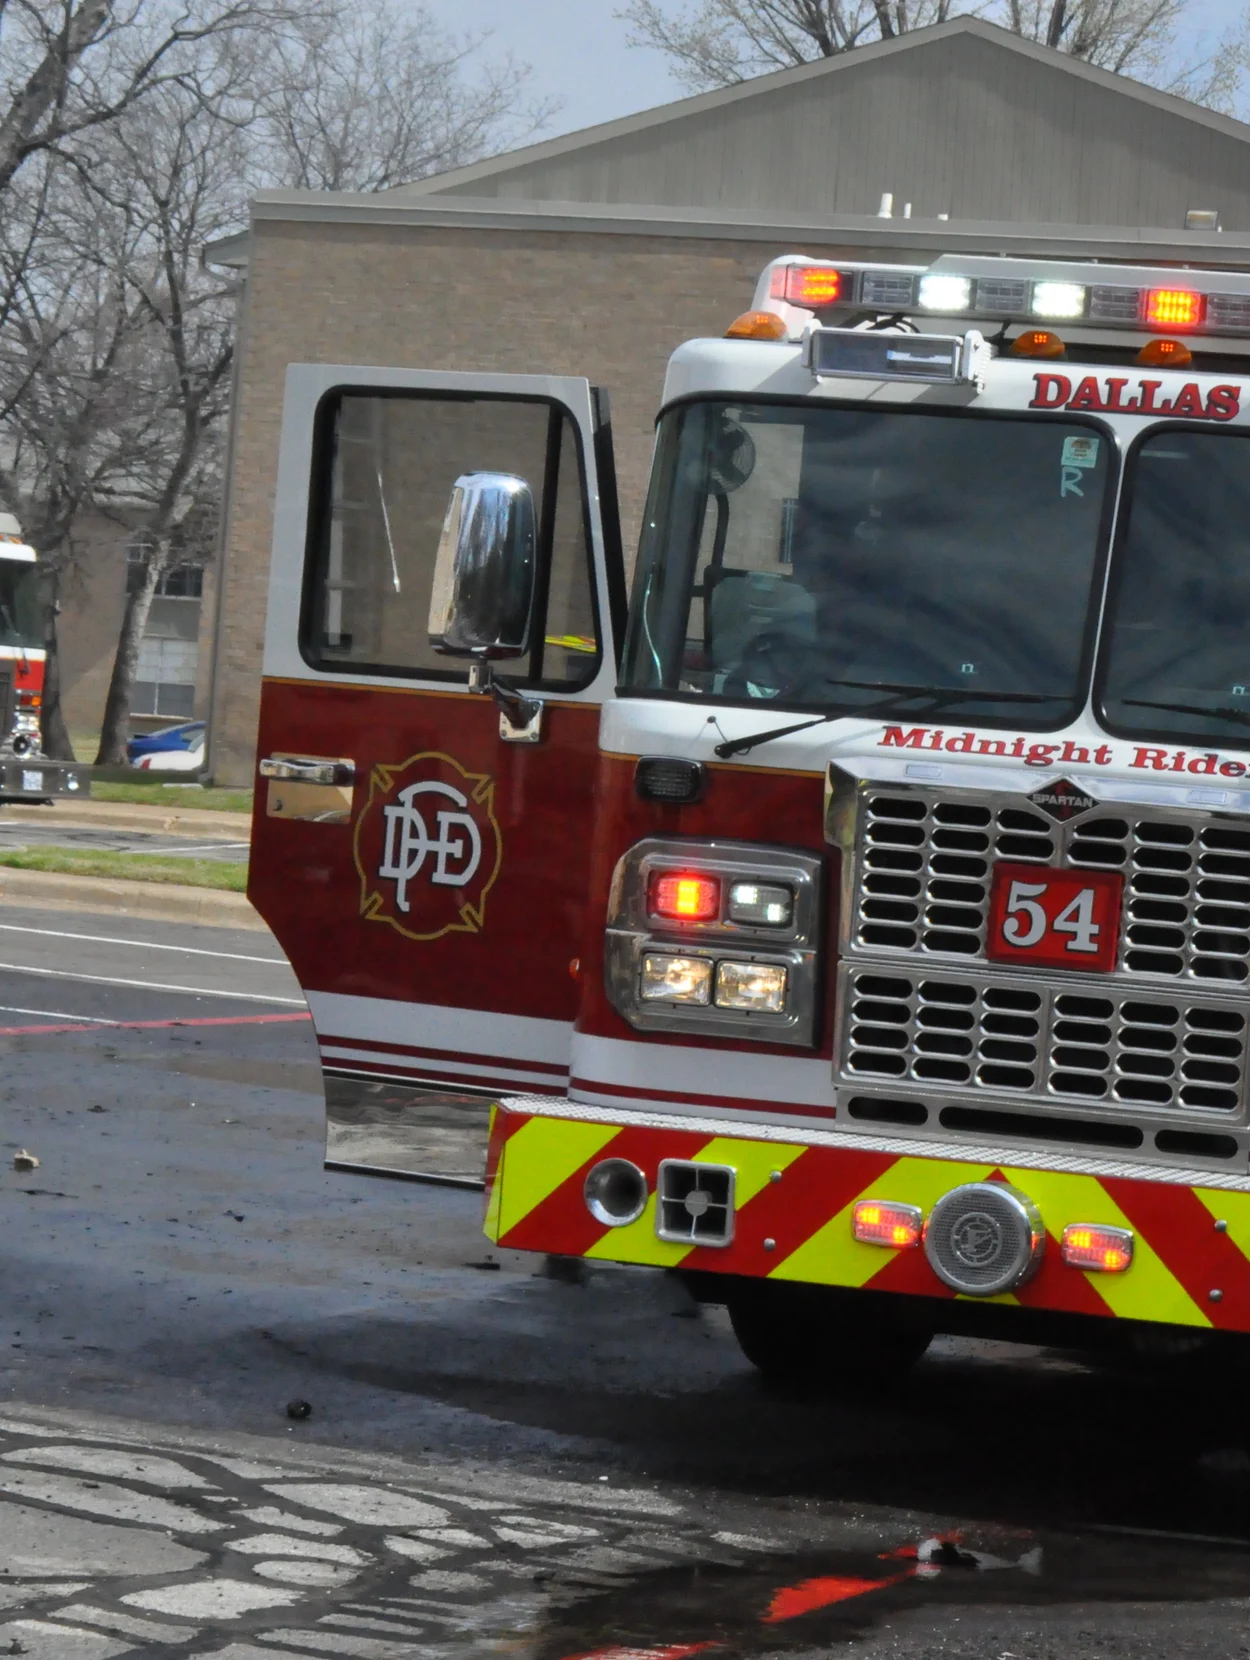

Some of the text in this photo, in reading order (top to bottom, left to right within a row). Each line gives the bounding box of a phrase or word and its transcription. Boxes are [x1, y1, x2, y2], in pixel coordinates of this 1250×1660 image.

[1028, 373, 1241, 422] DALLAS
[1060, 467, 1085, 498] R
[877, 726, 1113, 767] Midnight
[1032, 793, 1093, 808] SPARTAN
[1002, 880, 1100, 953] 54
